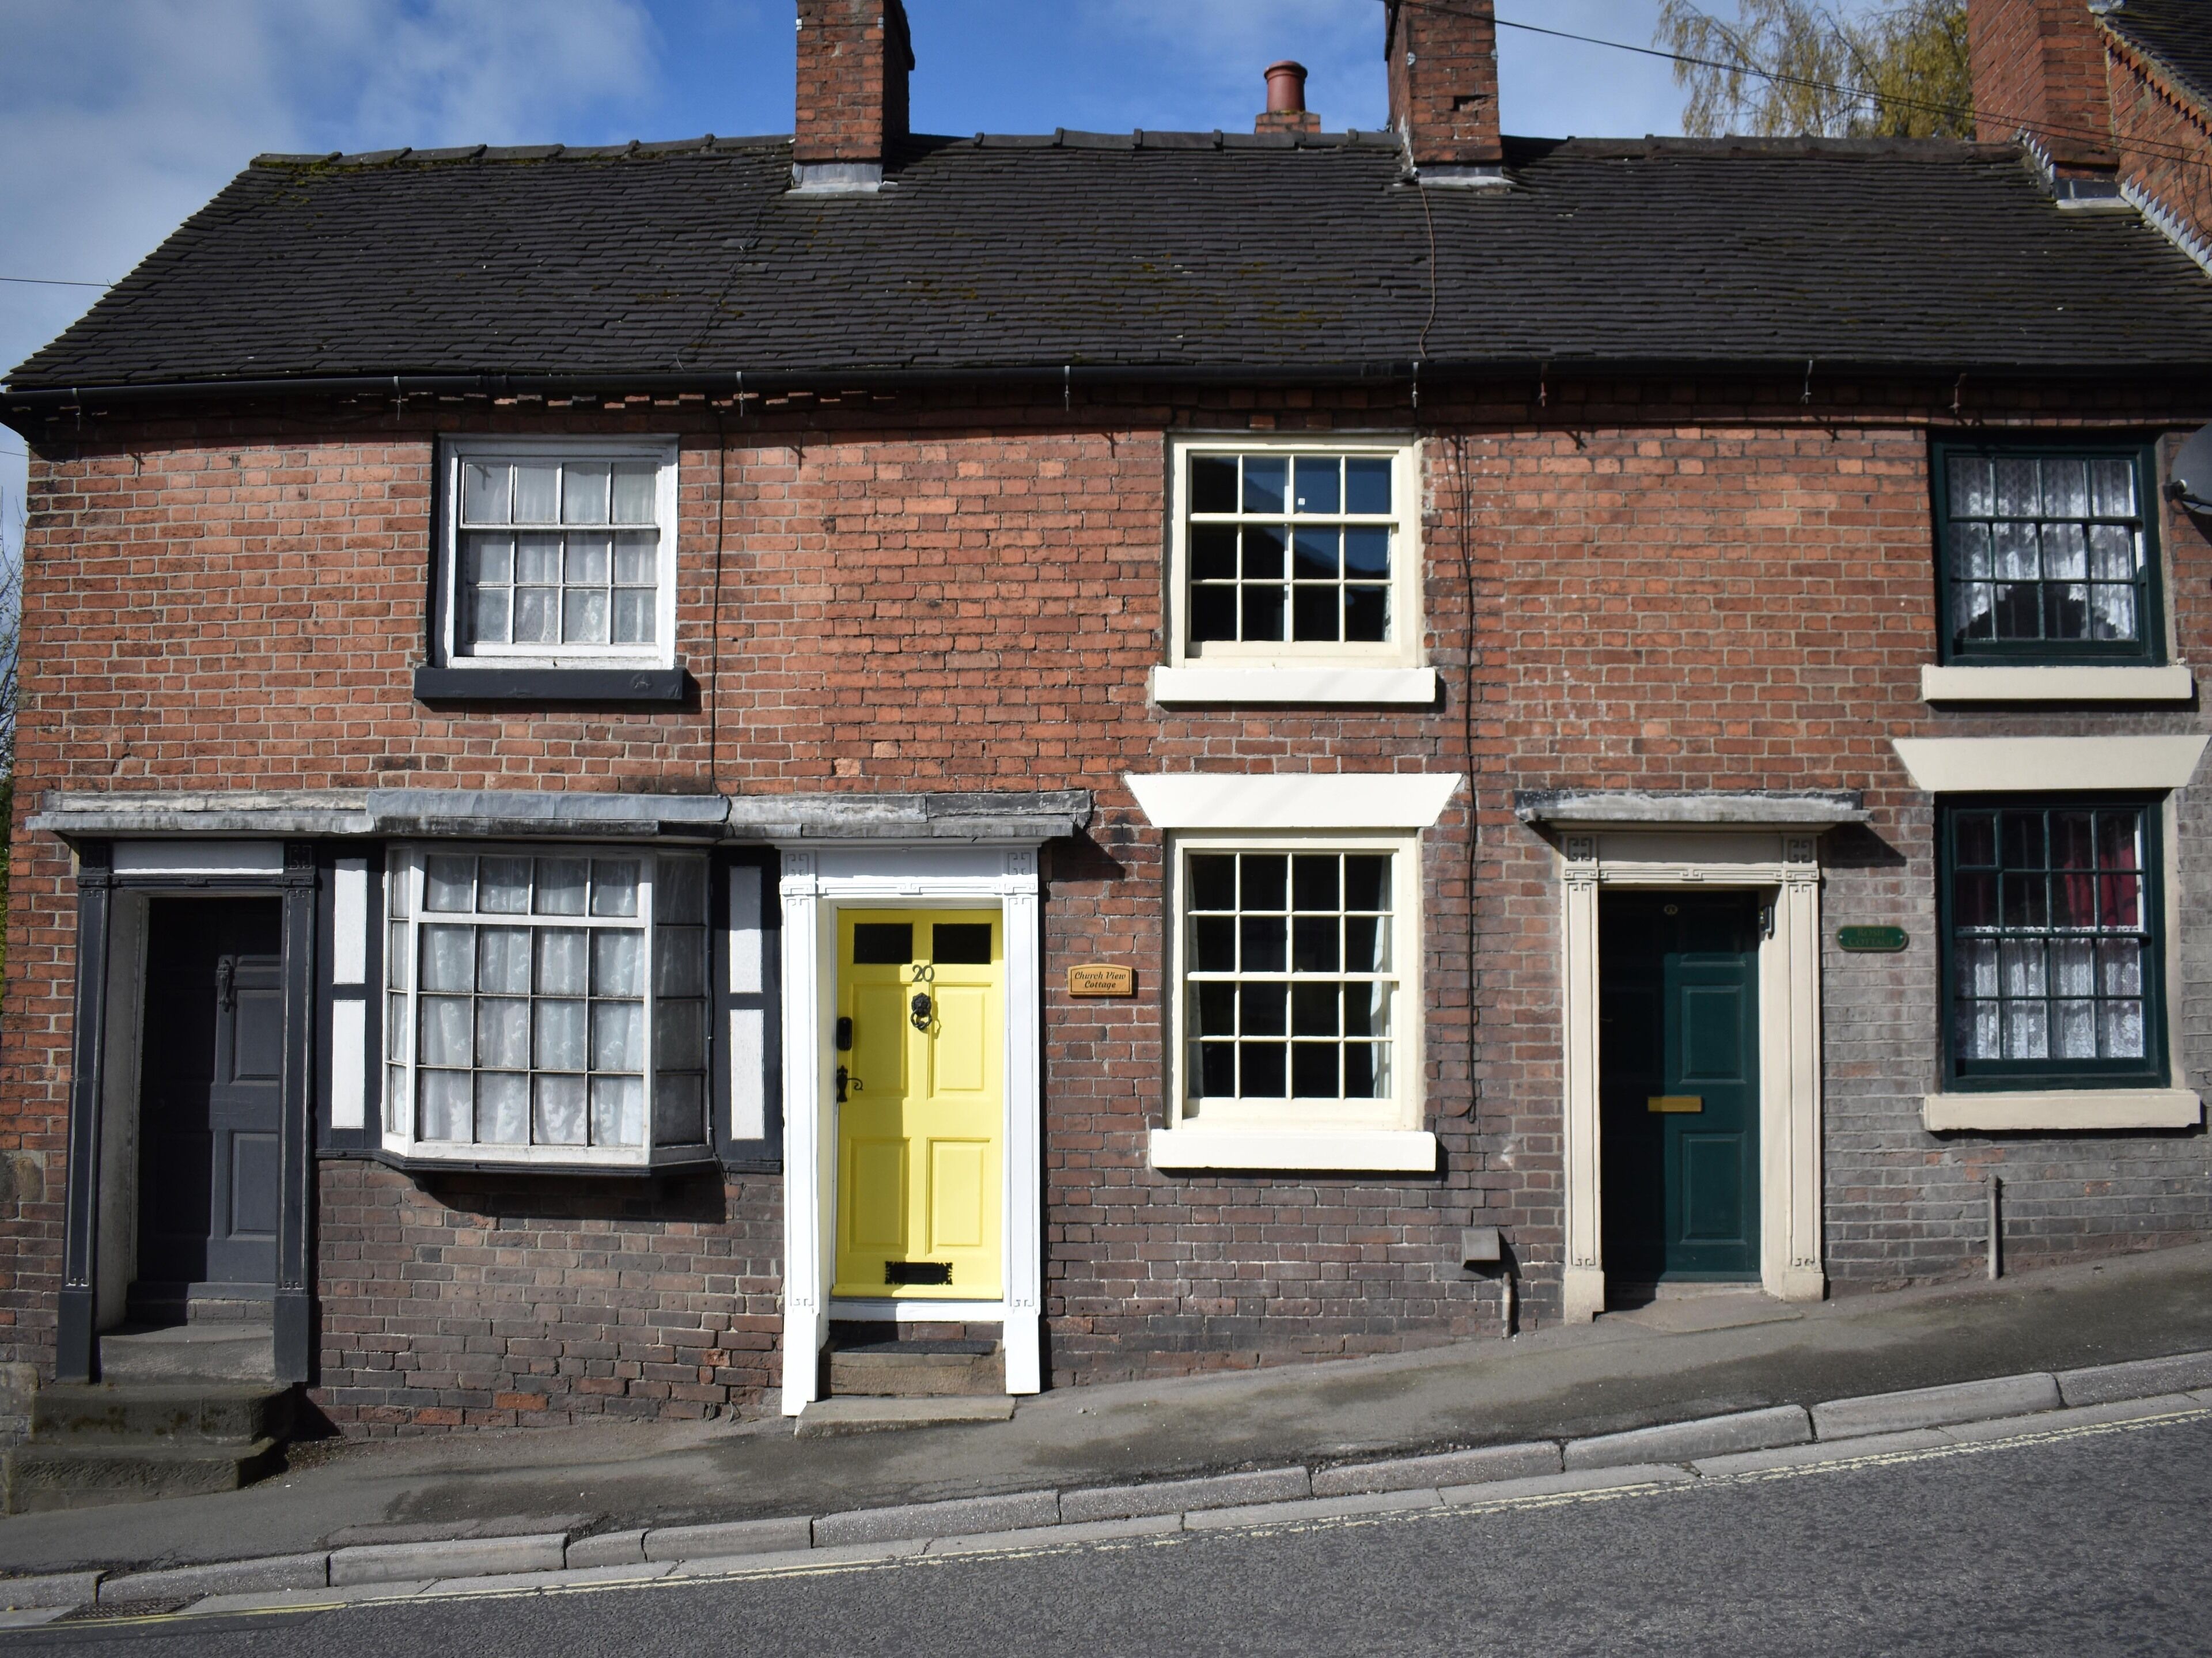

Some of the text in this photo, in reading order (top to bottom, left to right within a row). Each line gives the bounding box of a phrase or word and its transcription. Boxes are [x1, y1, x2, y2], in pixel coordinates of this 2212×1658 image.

[1848, 938, 1895, 946] COTTAGE
[912, 964, 935, 982] 20
[1074, 971, 1126, 980] Church View
[1085, 980, 1116, 990] Cottage
